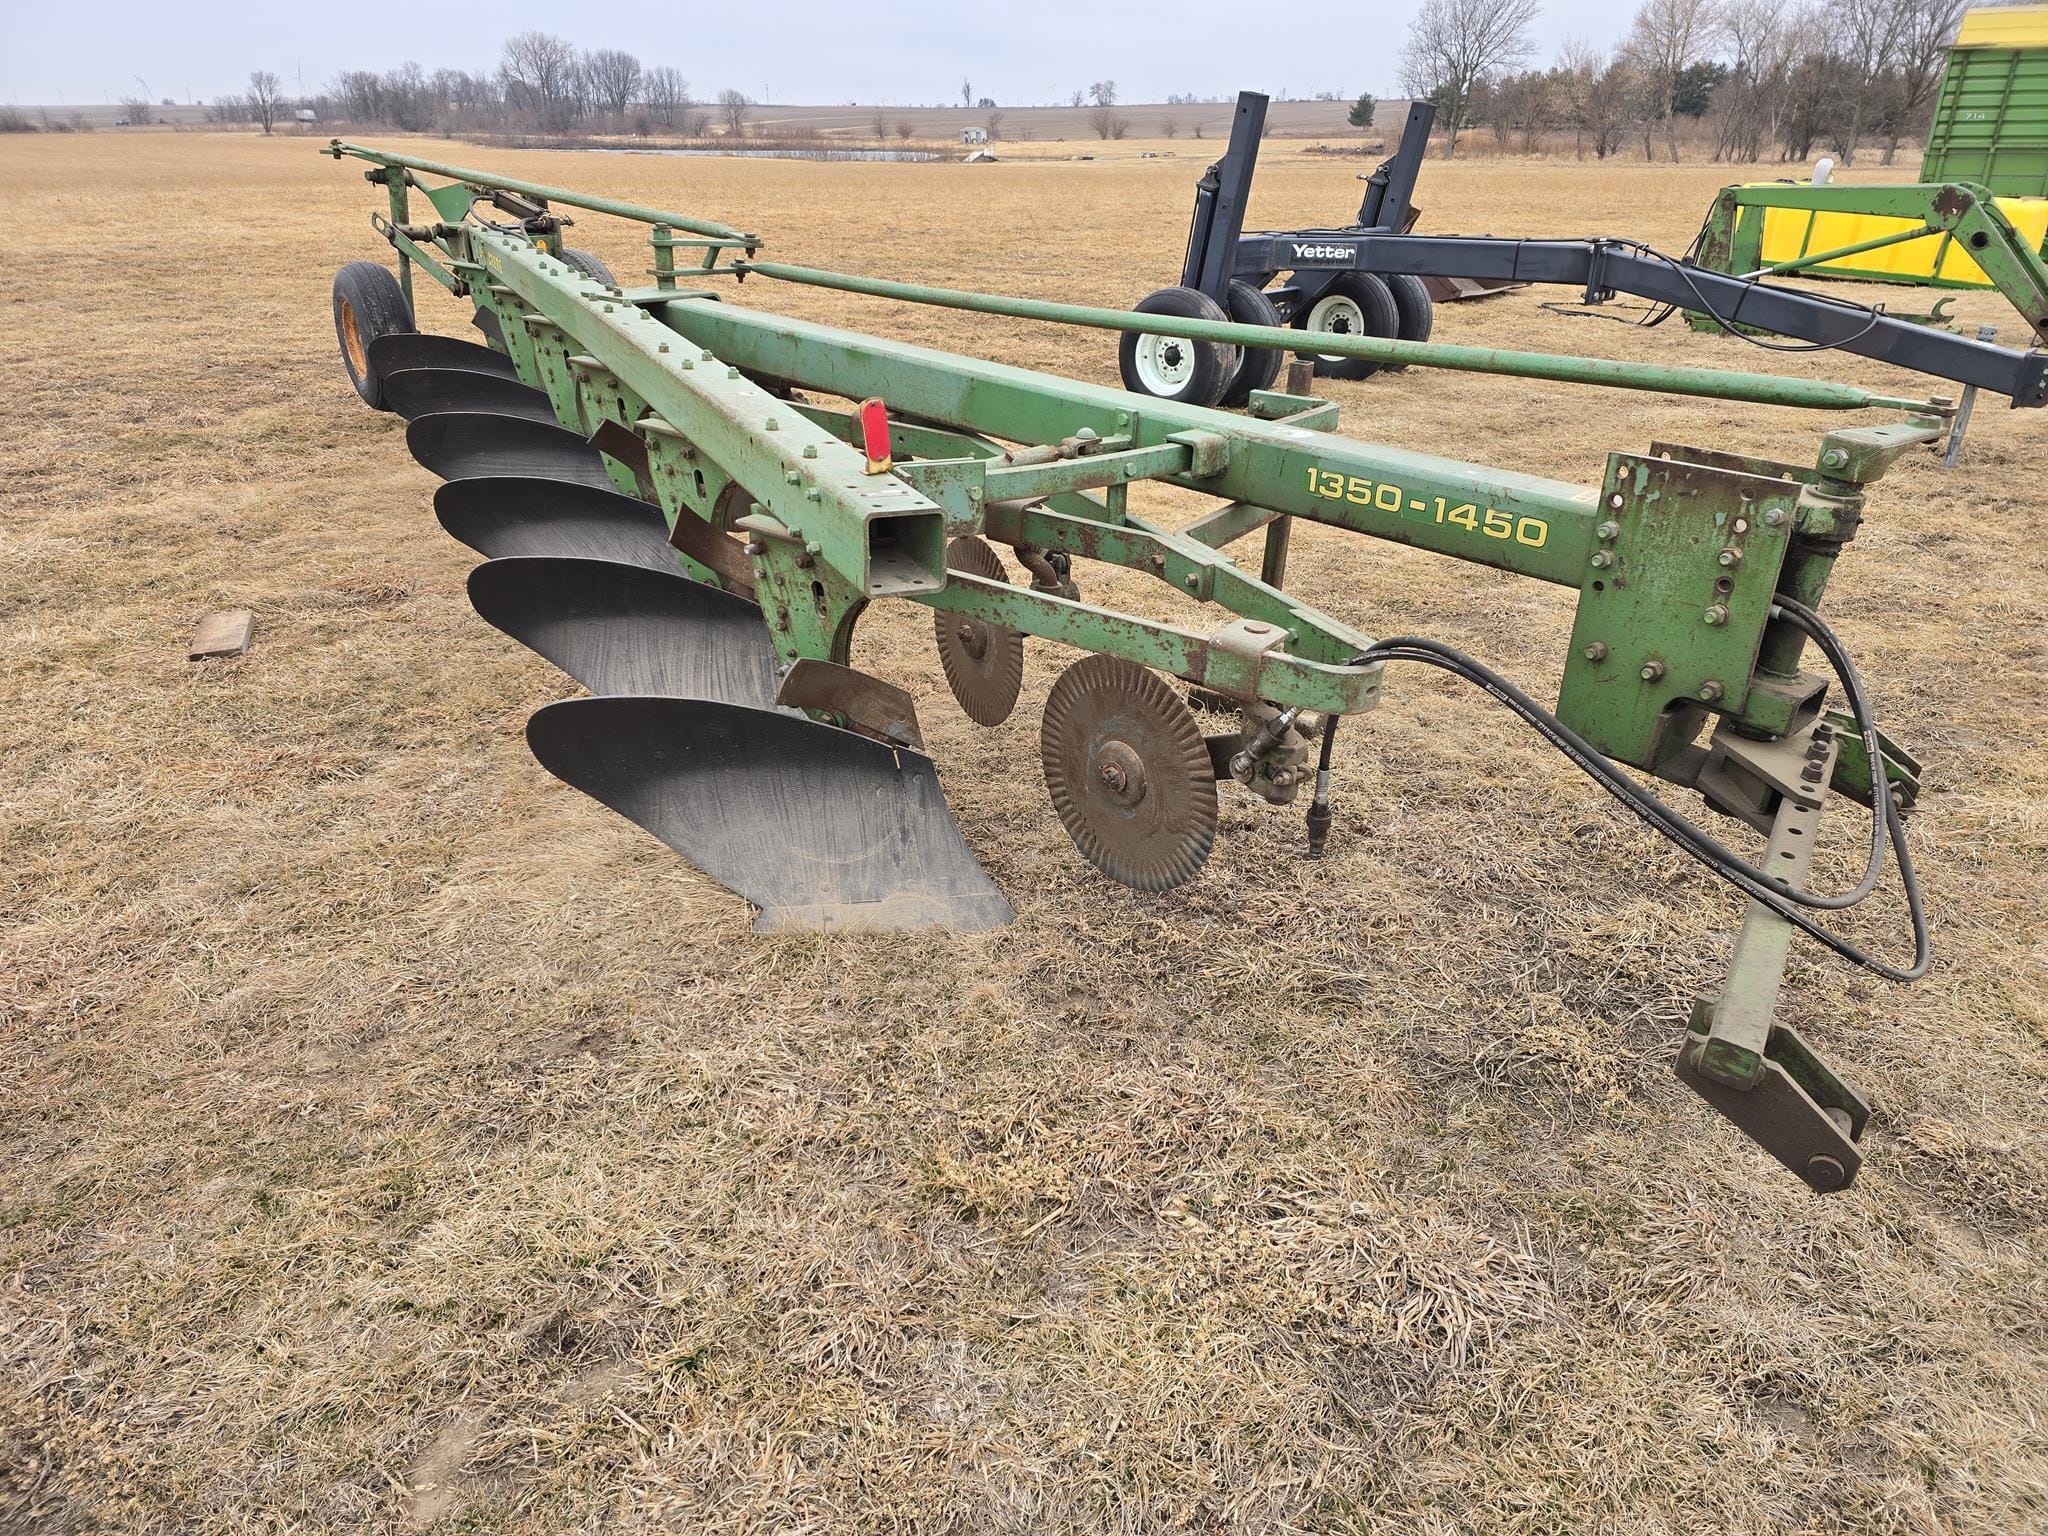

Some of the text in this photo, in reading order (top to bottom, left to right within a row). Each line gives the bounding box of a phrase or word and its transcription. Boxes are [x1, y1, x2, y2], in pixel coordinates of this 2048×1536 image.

[1966, 112, 1986, 120] 714
[1292, 243, 1355, 258] Yetter
[1306, 466, 1549, 549] 1350-1450
